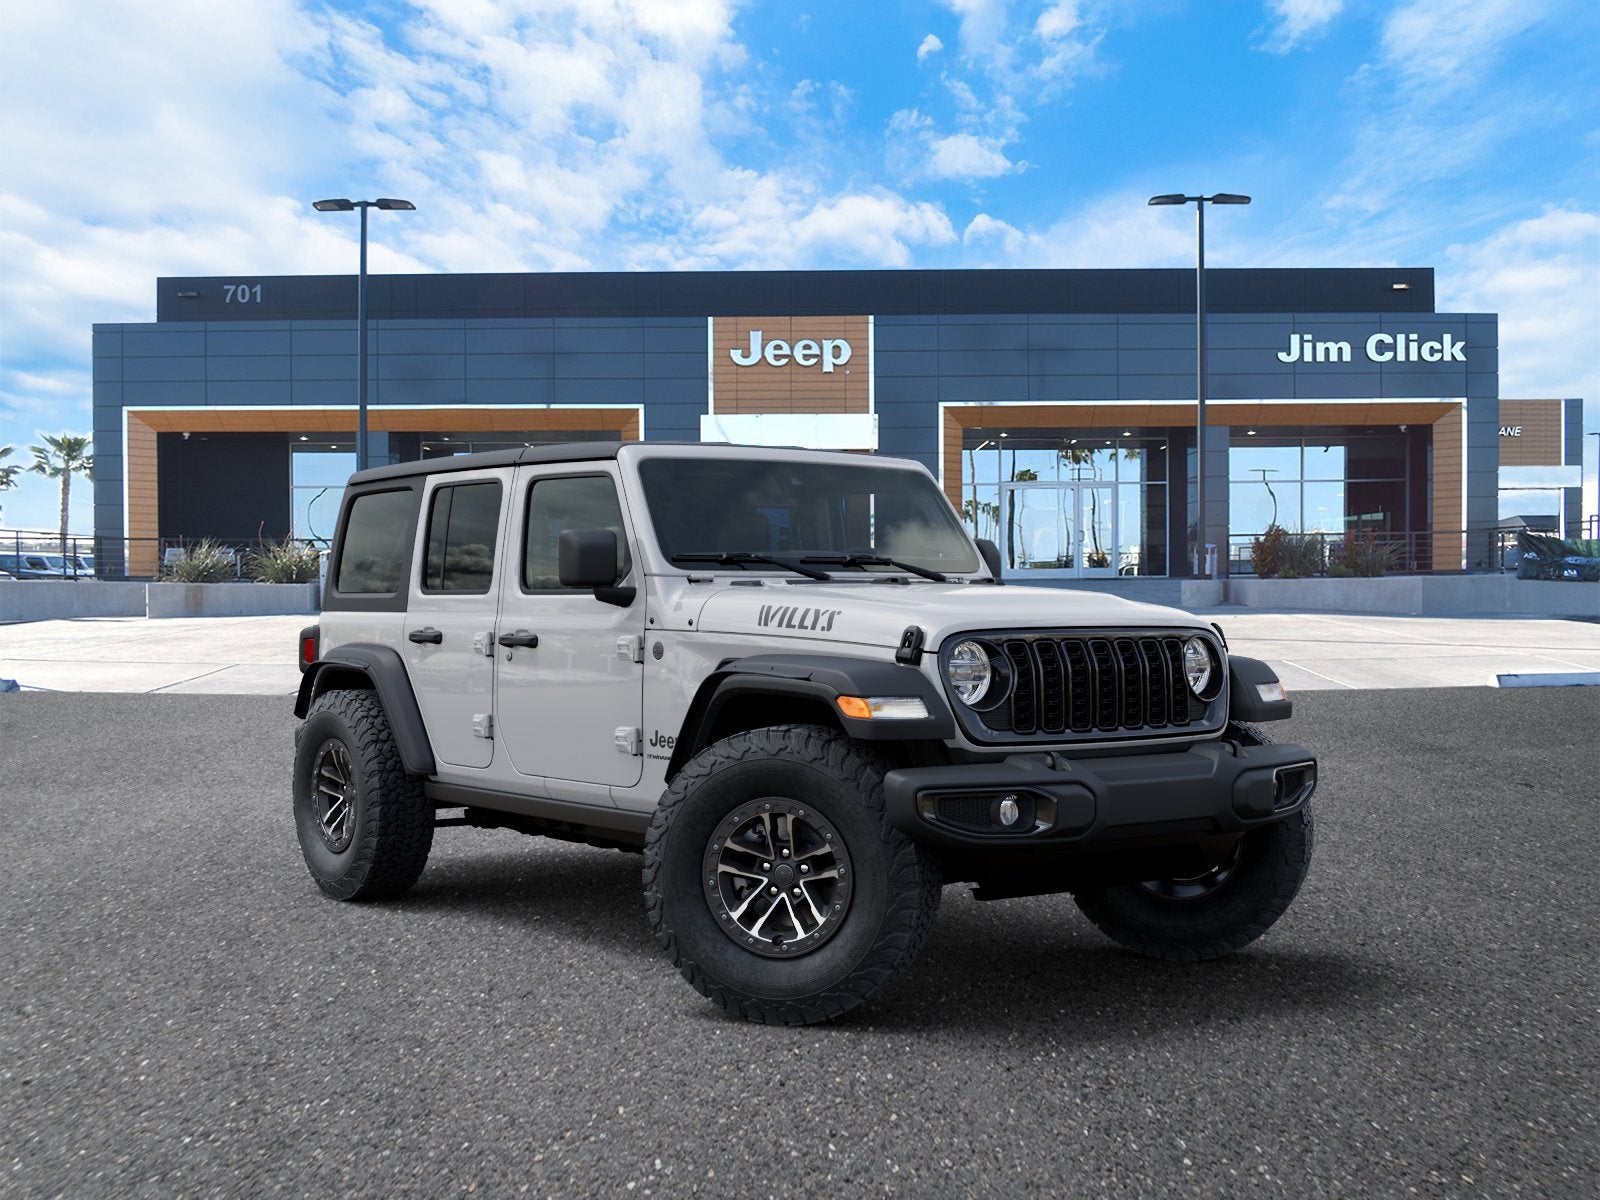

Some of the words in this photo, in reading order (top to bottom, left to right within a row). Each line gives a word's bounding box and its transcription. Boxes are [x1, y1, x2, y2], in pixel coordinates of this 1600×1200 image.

[223, 284, 262, 303] 701
[730, 330, 852, 373] Jeep
[1277, 333, 1351, 363] Jim
[1366, 333, 1467, 363] Click
[757, 605, 842, 632] WILLYS
[649, 730, 678, 750] Jee
